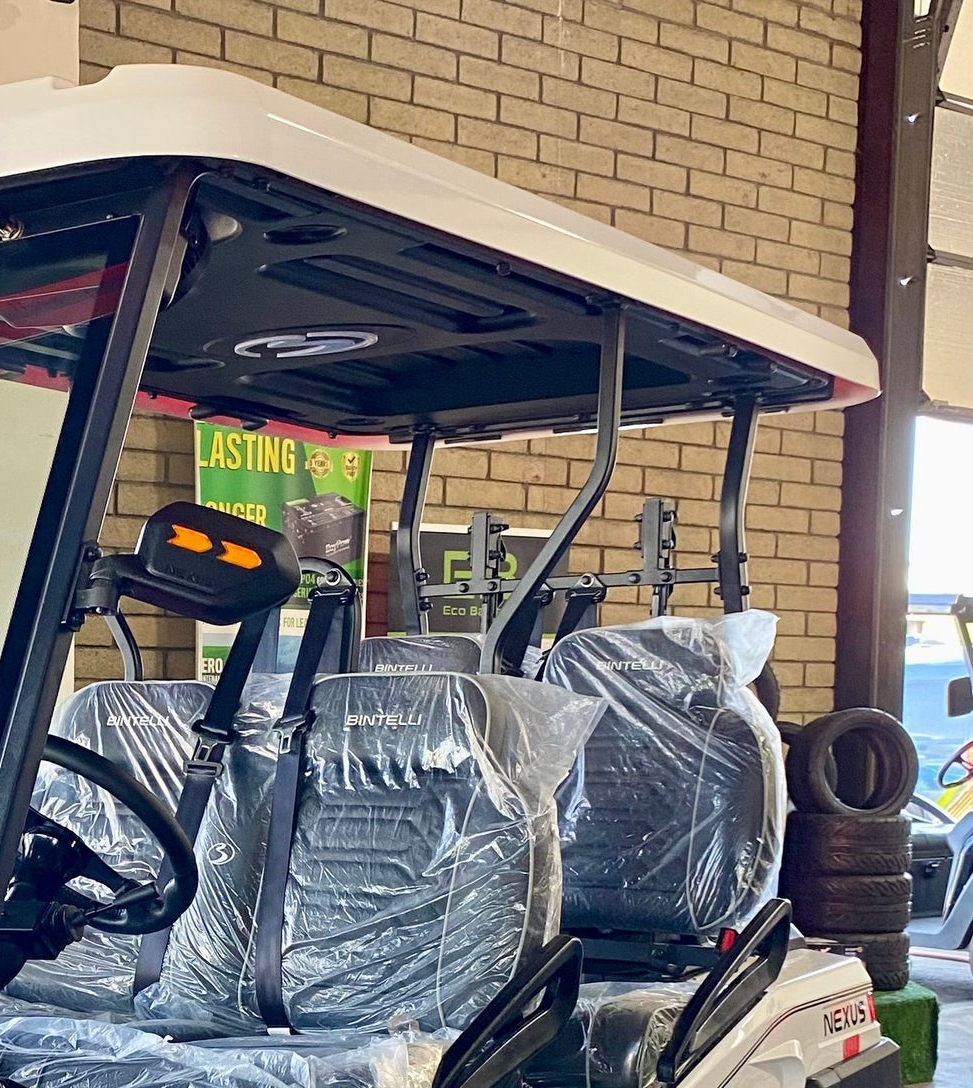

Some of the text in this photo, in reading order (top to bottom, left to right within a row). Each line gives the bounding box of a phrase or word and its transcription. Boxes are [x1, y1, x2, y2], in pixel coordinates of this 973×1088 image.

[197, 429, 296, 475] LASTING
[443, 605, 466, 616] Eco
[283, 617, 295, 628] FOR
[595, 660, 663, 671] BINTELLI
[106, 715, 170, 727] BINTELLI
[346, 713, 423, 726] BINTELLI
[823, 1000, 867, 1037] NEXUS
